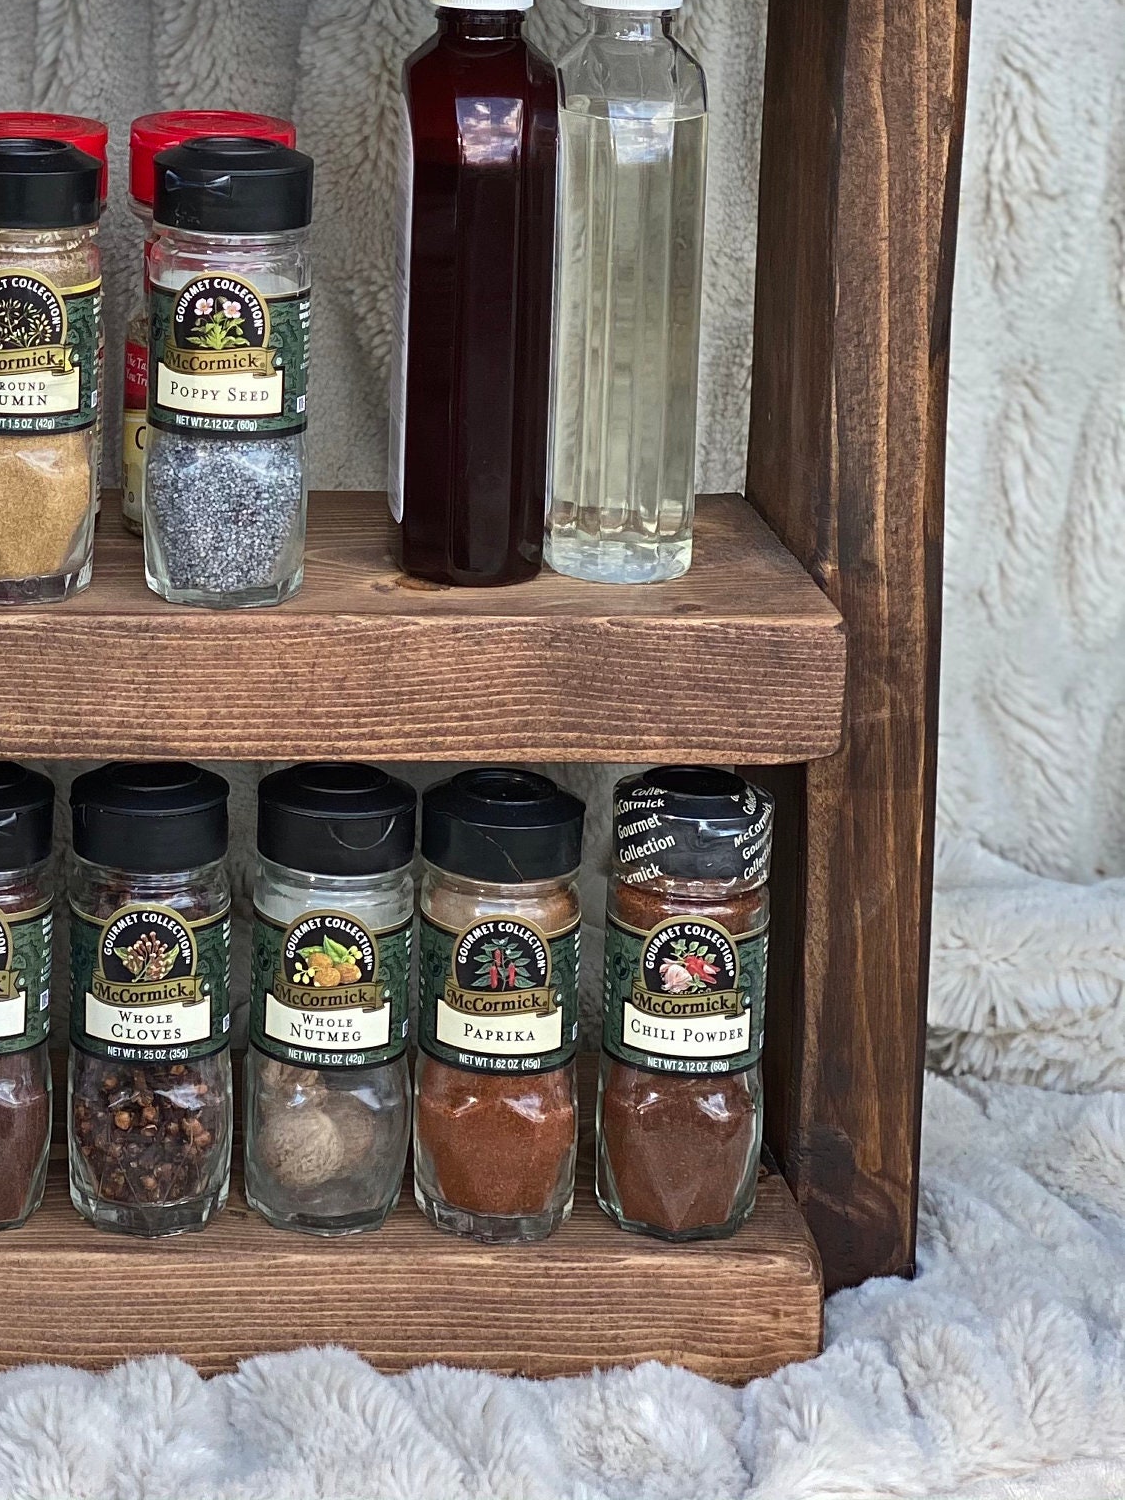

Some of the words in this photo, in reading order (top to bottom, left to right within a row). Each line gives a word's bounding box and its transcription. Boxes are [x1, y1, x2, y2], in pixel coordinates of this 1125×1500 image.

[176, 280, 209, 322] GOURMET
[166, 352, 260, 370] McCormick
[171, 381, 221, 400] POPPY
[228, 388, 269, 401] SEED
[9, 418, 20, 428] 1.5
[21, 419, 32, 428] OZ
[176, 415, 190, 426] NET
[191, 417, 203, 427] WT
[205, 419, 221, 428] 2.12
[223, 420, 234, 429] OZ
[618, 813, 662, 840] Gourmet
[620, 834, 676, 864] Collection
[104, 914, 138, 956] GOURMET
[286, 918, 321, 958] GOURMET
[458, 923, 494, 964] GOURMET
[646, 926, 681, 969] GOURMET
[95, 983, 187, 1003] McCormick
[276, 986, 367, 1006] McCormick
[447, 990, 540, 1012] McCormick
[635, 993, 729, 1014] McCormick
[118, 1010, 173, 1023] WHOLE
[302, 1013, 353, 1027] WHOLE
[111, 1024, 181, 1040] CLOVES
[290, 1023, 362, 1042] NUTMEG
[464, 1023, 535, 1041] PAPRIKA
[631, 1019, 675, 1040] CHILI
[683, 1028, 743, 1042] POWDER
[108, 1046, 121, 1056] NET
[123, 1048, 135, 1058] WT
[137, 1050, 153, 1059] 1.25
[155, 1049, 166, 1059] OZ
[289, 1049, 302, 1060] NET
[304, 1052, 316, 1061] WT
[318, 1053, 330, 1063] 1.5
[332, 1054, 342, 1064] OZ
[459, 1053, 473, 1064] NET
[475, 1056, 487, 1066] WT
[490, 1058, 506, 1068] 1.62
[507, 1058, 518, 1069] OZ
[648, 1057, 661, 1068] NET
[664, 1059, 677, 1070] WT
[679, 1060, 695, 1071] 2.12
[697, 1061, 708, 1071] OZ
